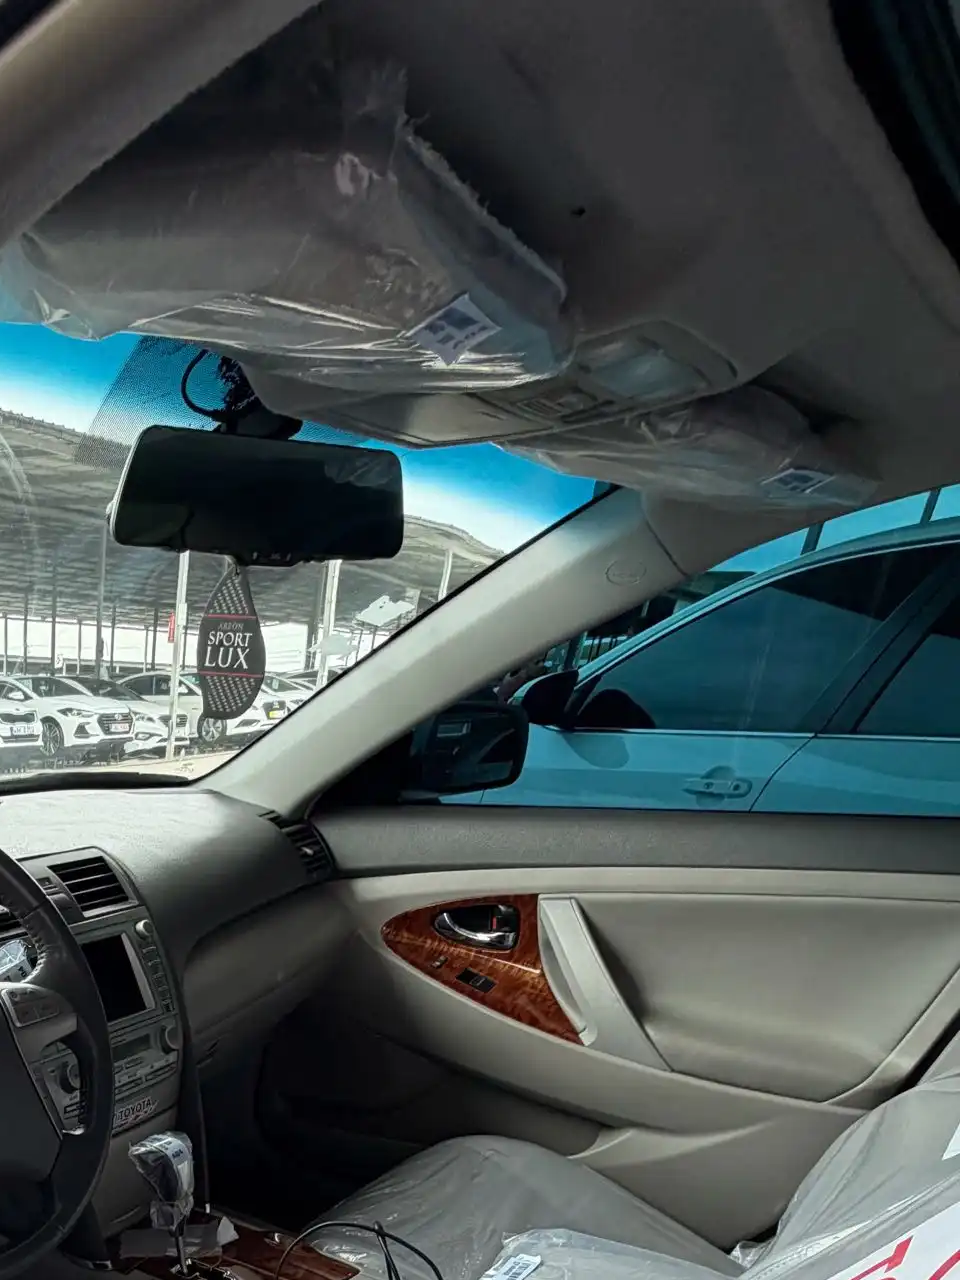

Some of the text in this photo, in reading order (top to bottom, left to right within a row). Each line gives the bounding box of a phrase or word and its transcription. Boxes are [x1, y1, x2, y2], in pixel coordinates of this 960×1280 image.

[207, 631, 253, 647] SPORT
[204, 646, 250, 669] LUX
[118, 1098, 151, 1120] TOYOTA
